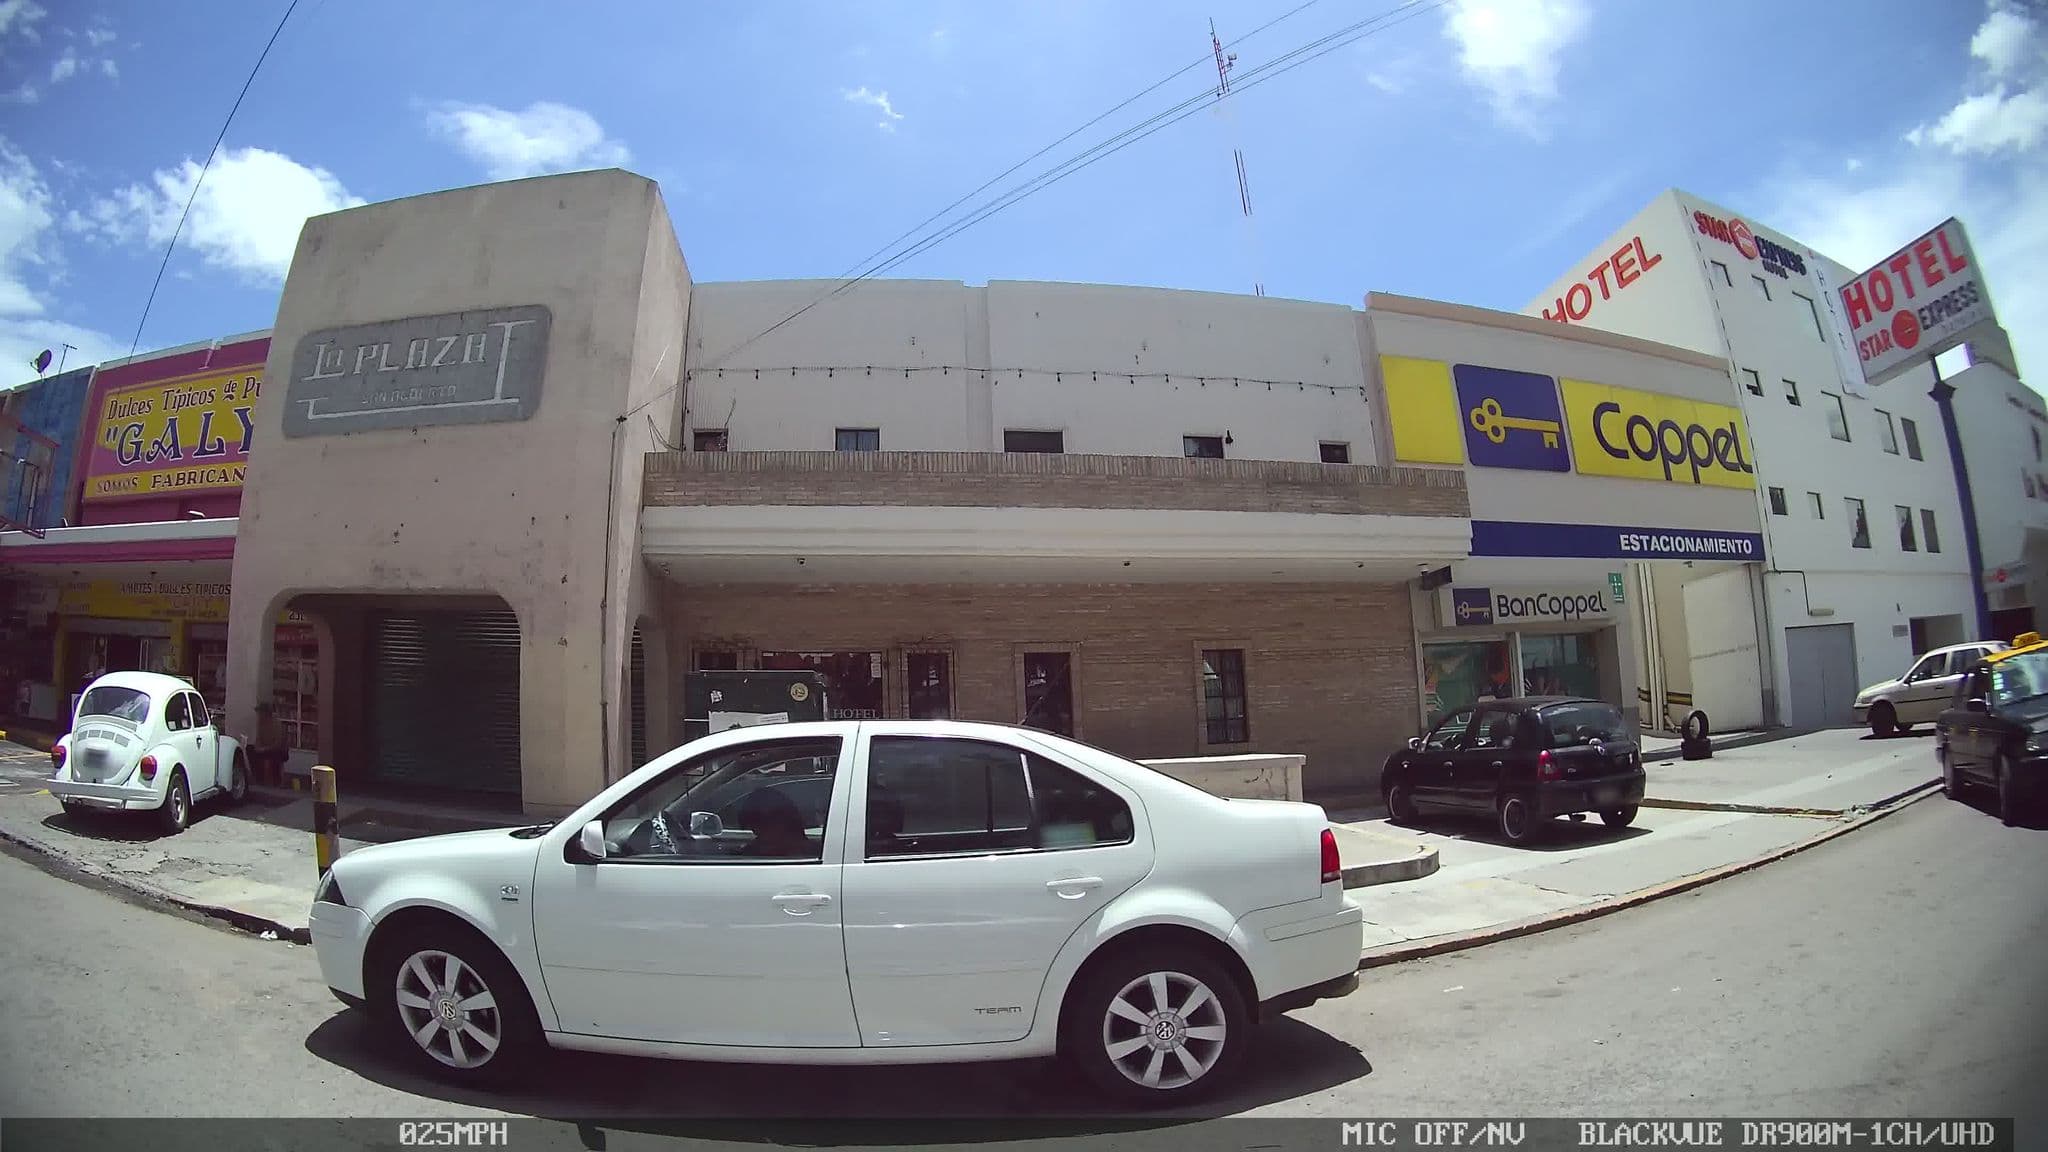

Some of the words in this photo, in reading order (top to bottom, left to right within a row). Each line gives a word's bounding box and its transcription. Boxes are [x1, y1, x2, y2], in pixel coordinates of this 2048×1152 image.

[1543, 236, 1662, 323] HOTEL
[1843, 230, 1968, 330] HOTEL
[1859, 329, 1894, 361] STAR
[1917, 281, 1979, 331] EXPRESS
[353, 333, 488, 375] PLAZA
[107, 397, 153, 420] Dulces
[163, 386, 216, 413] Típicos
[224, 379, 237, 395] de
[1593, 402, 1753, 484] Coppel
[1620, 534, 1752, 554] ESTACIONAMIENTO
[1497, 591, 1607, 622] BanCoppel
[833, 708, 879, 719] HOTEL
[974, 1006, 1022, 1015] TEAM
